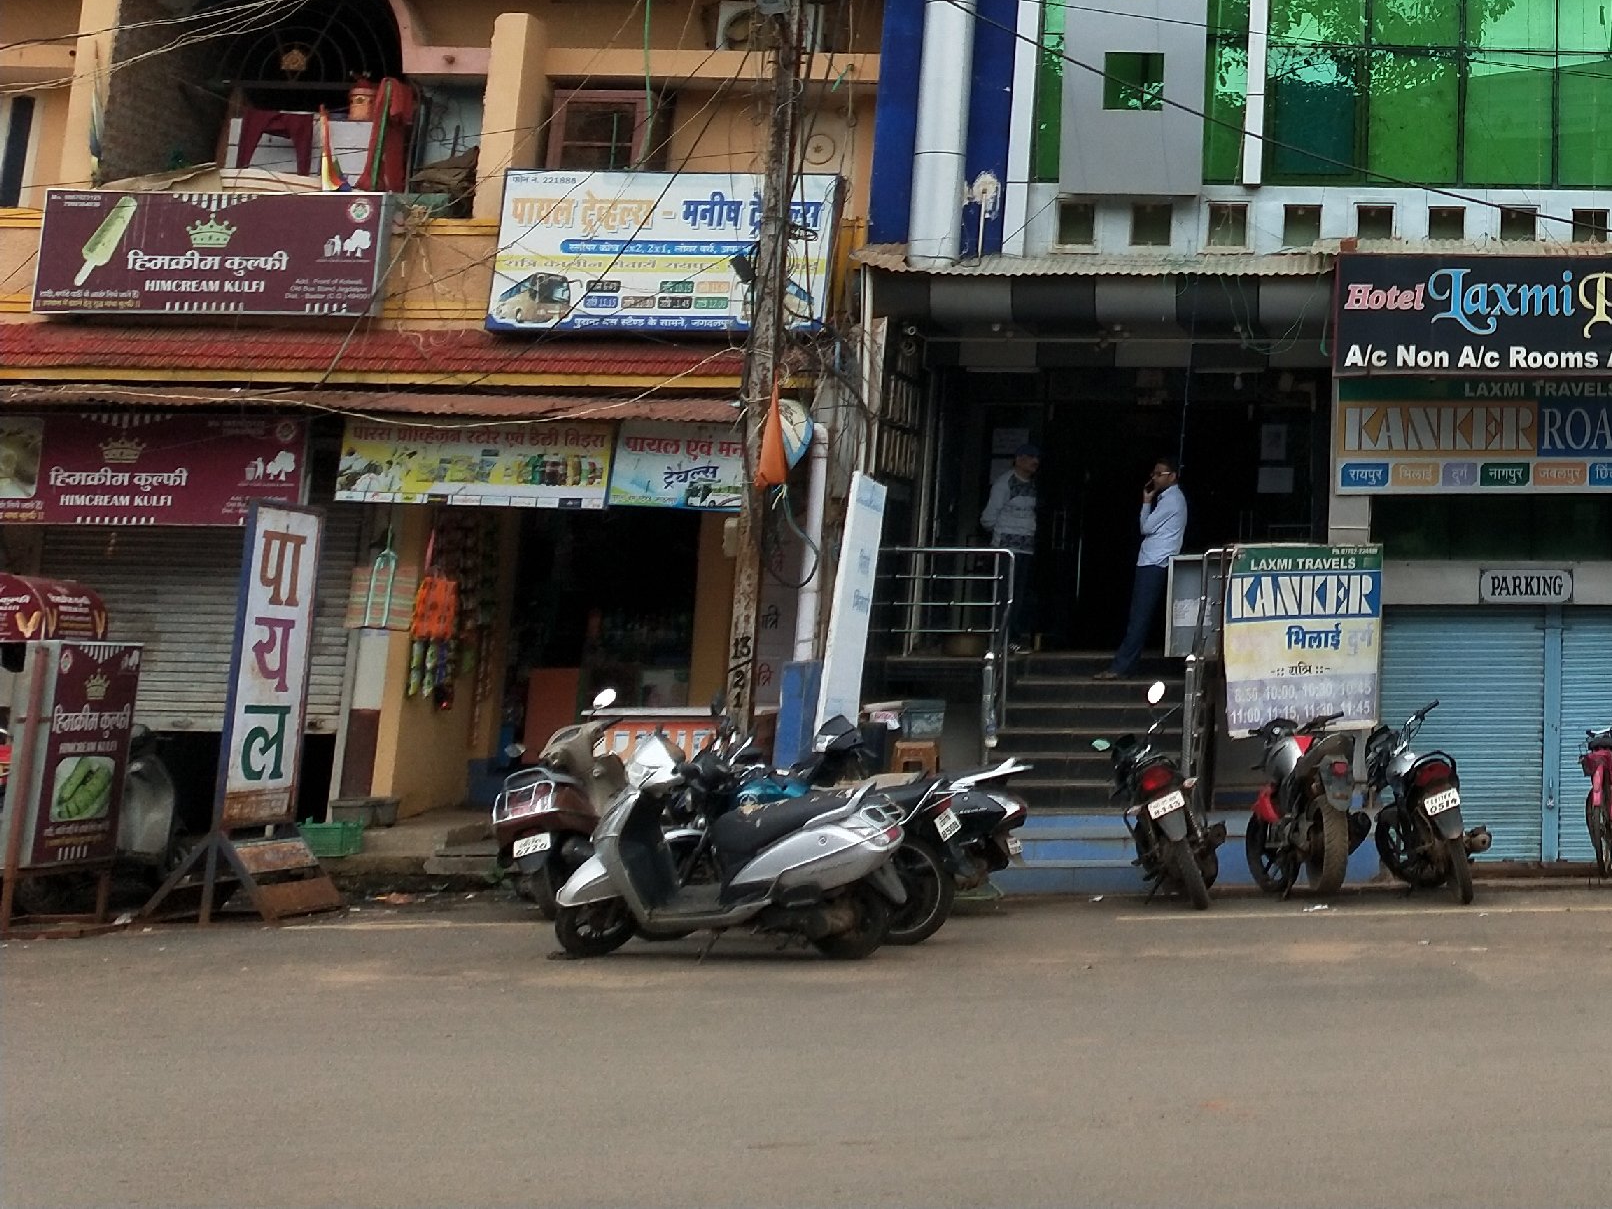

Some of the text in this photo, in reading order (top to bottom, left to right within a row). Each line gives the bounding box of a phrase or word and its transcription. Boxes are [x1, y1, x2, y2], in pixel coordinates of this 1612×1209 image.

[511, 197, 575, 228] पायल
[683, 192, 744, 229] मनीष
[127, 250, 290, 276] हिमक्रीम कुल्फी
[145, 279, 264, 293] HIMCREAM KULFI
[1344, 283, 1425, 311] Hotel
[1427, 268, 1575, 336] Laxmi
[1344, 344, 1387, 368] A/c
[1396, 345, 1450, 369] Non
[1457, 345, 1501, 369] A/c
[1509, 345, 1599, 369] Rooms
[1464, 381, 1527, 398] LAXMI
[352, 426, 392, 441] पारस
[466, 426, 501, 444] स्टोर
[505, 426, 524, 448] एवं
[1344, 406, 1537, 453] KANKER
[625, 436, 681, 455] पायल
[686, 435, 713, 461] एवं
[49, 466, 188, 491] हिमक्रीम कुल्फी
[1349, 468, 1382, 485] रायपुर
[1399, 465, 1433, 480] भिलाई
[1488, 468, 1523, 484] नागपुर
[1539, 468, 1580, 484] जबलपुर
[60, 494, 172, 506] HIMCREAM KULFI
[1250, 557, 1356, 570] LAXMI TRAVELS
[1232, 575, 1373, 619] KANKER
[1490, 574, 1564, 597] PARKING
[1286, 622, 1341, 650] भिलाई
[241, 525, 307, 781] पायल
[1288, 661, 1313, 676] रात्रि
[52, 703, 130, 738] हिमक्रीम कुल्फी
